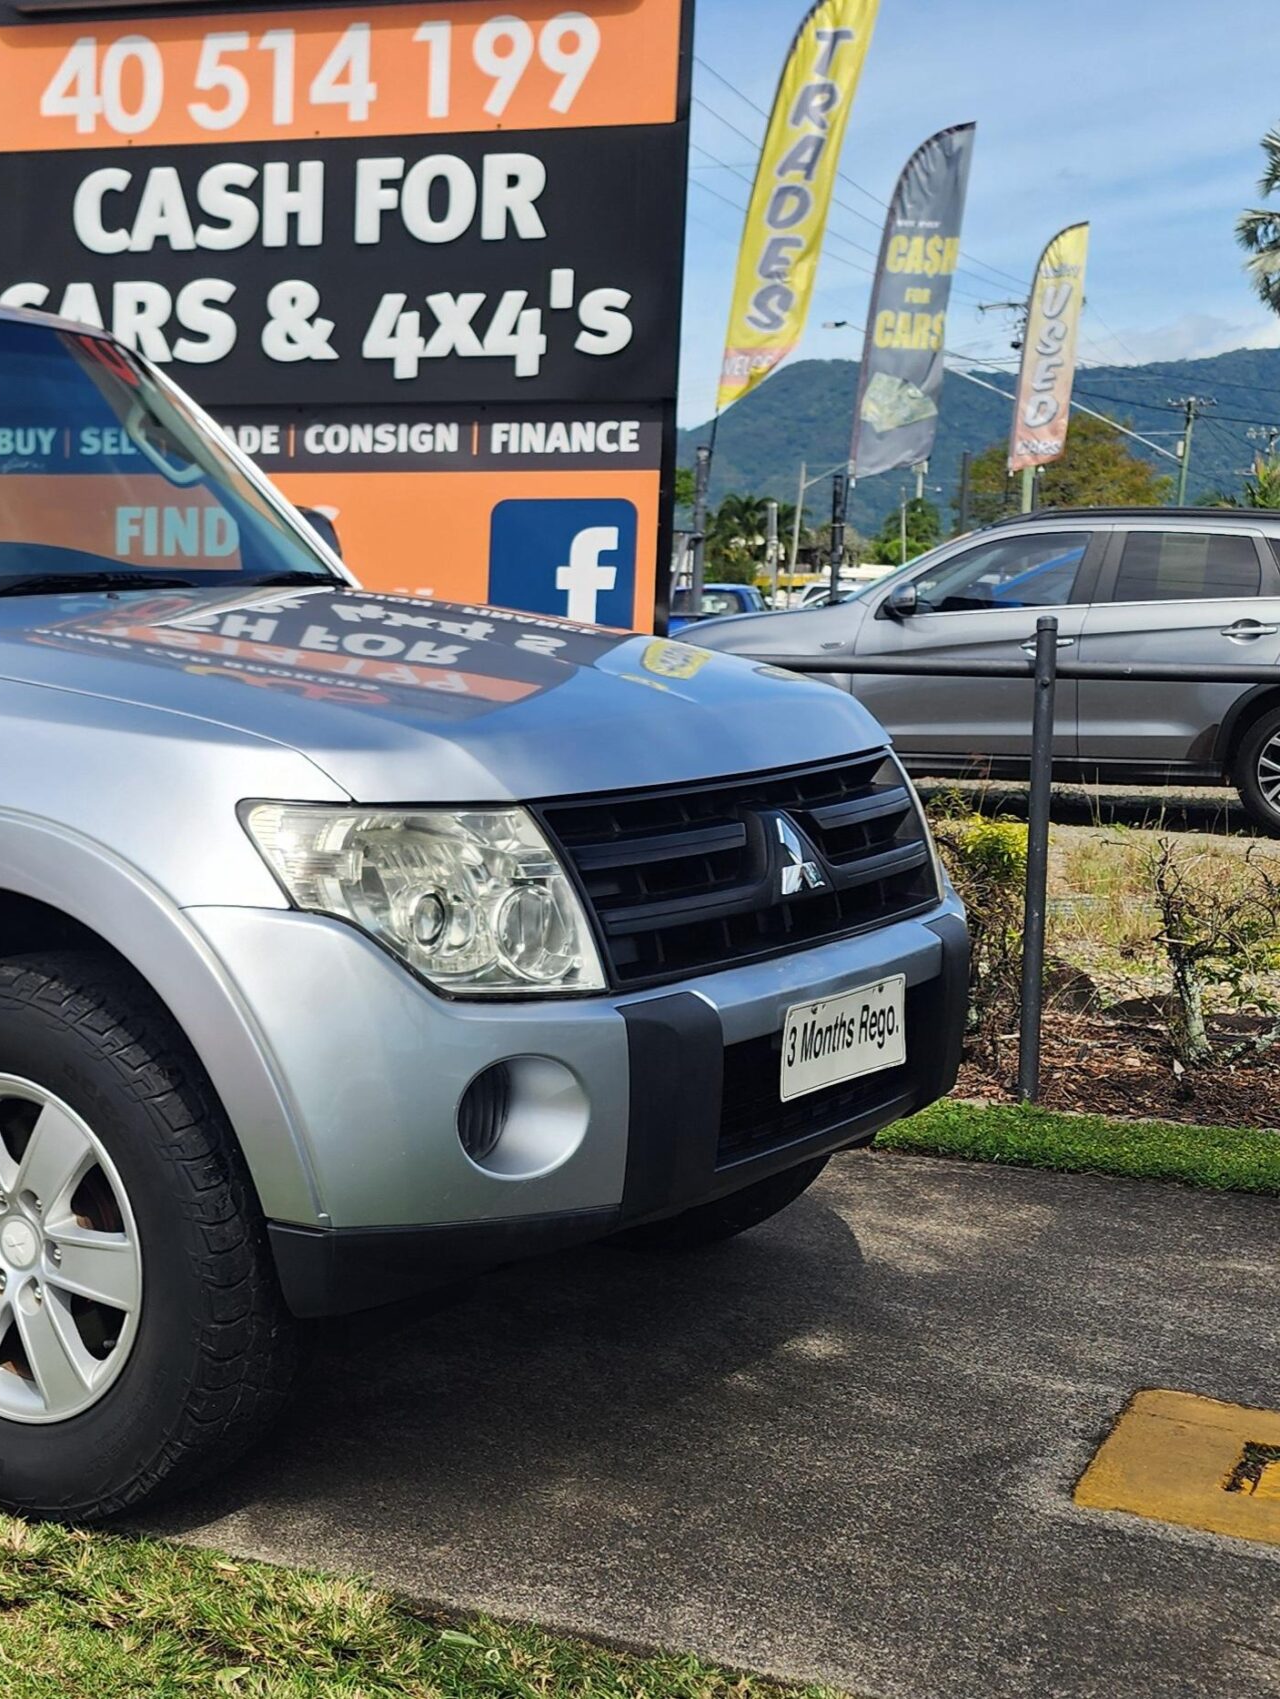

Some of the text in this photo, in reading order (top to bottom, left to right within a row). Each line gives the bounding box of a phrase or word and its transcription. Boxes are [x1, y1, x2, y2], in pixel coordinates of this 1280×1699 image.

[40, 11, 601, 135] 40 514 199
[73, 152, 547, 254] CASH FOR
[745, 28, 854, 332] TRADES
[260, 279, 339, 362] &
[1023, 282, 1072, 428] USED
[304, 423, 458, 454] CONSIGN
[491, 421, 640, 454] FINANCE
[115, 505, 240, 557] FIND
[787, 1004, 899, 1068] 3 Months Rego.
